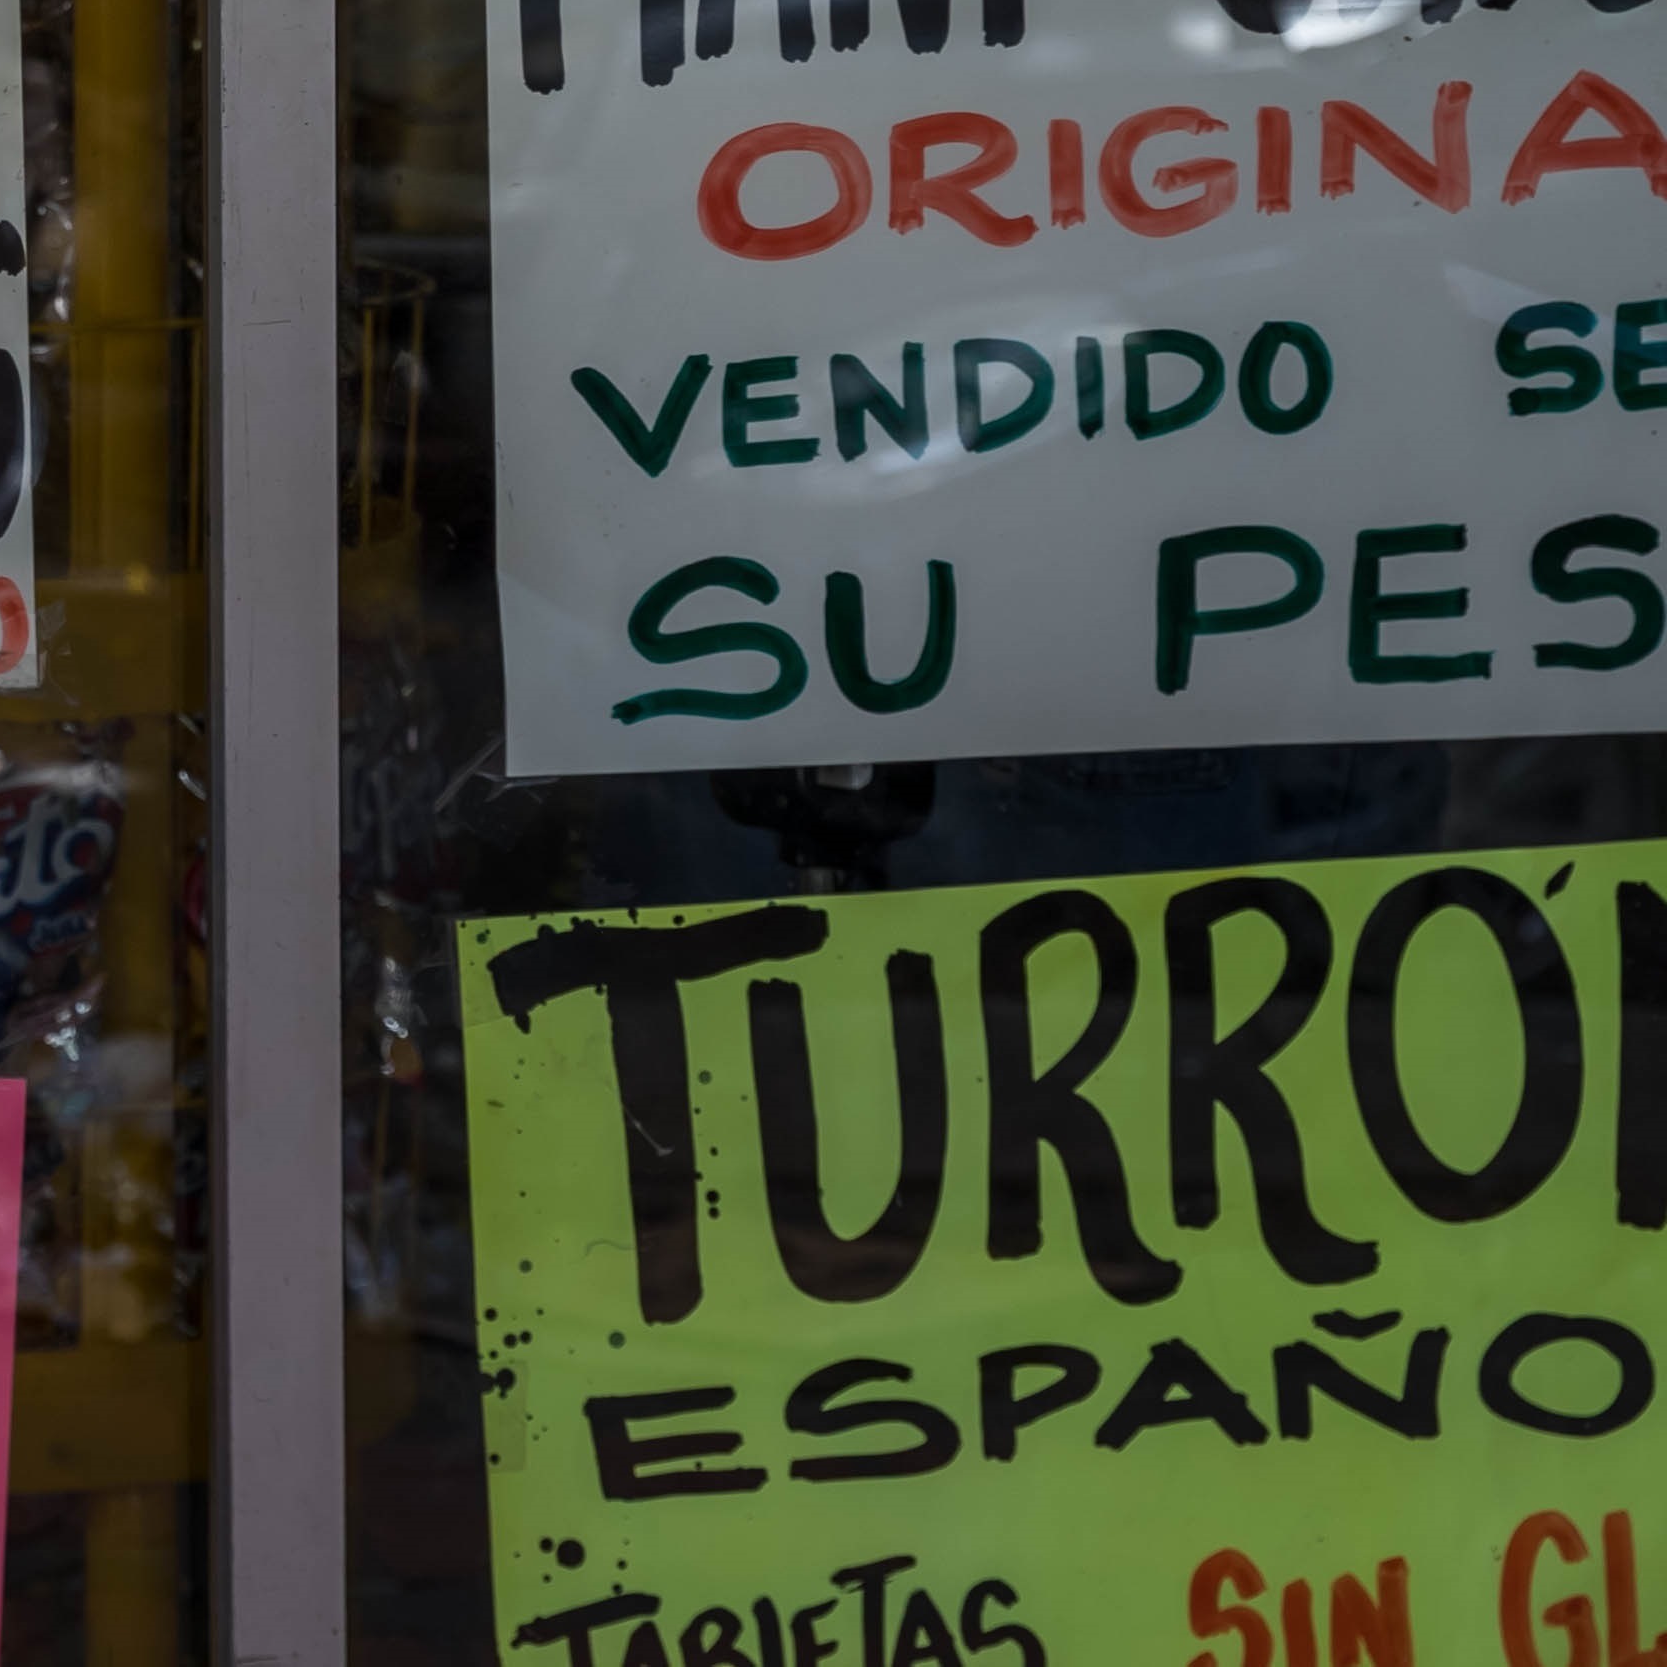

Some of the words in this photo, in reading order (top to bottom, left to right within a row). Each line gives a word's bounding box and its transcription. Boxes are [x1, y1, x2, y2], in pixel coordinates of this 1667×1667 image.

[696, 71, 1667, 261] ORIGINA
[570, 321, 1334, 476] VENDIDO
[611, 554, 956, 725] SU
[1157, 515, 1667, 695] PES
[585, 1310, 1655, 1501] ESPAÑO
[1187, 1548, 1410, 1667] SIN
